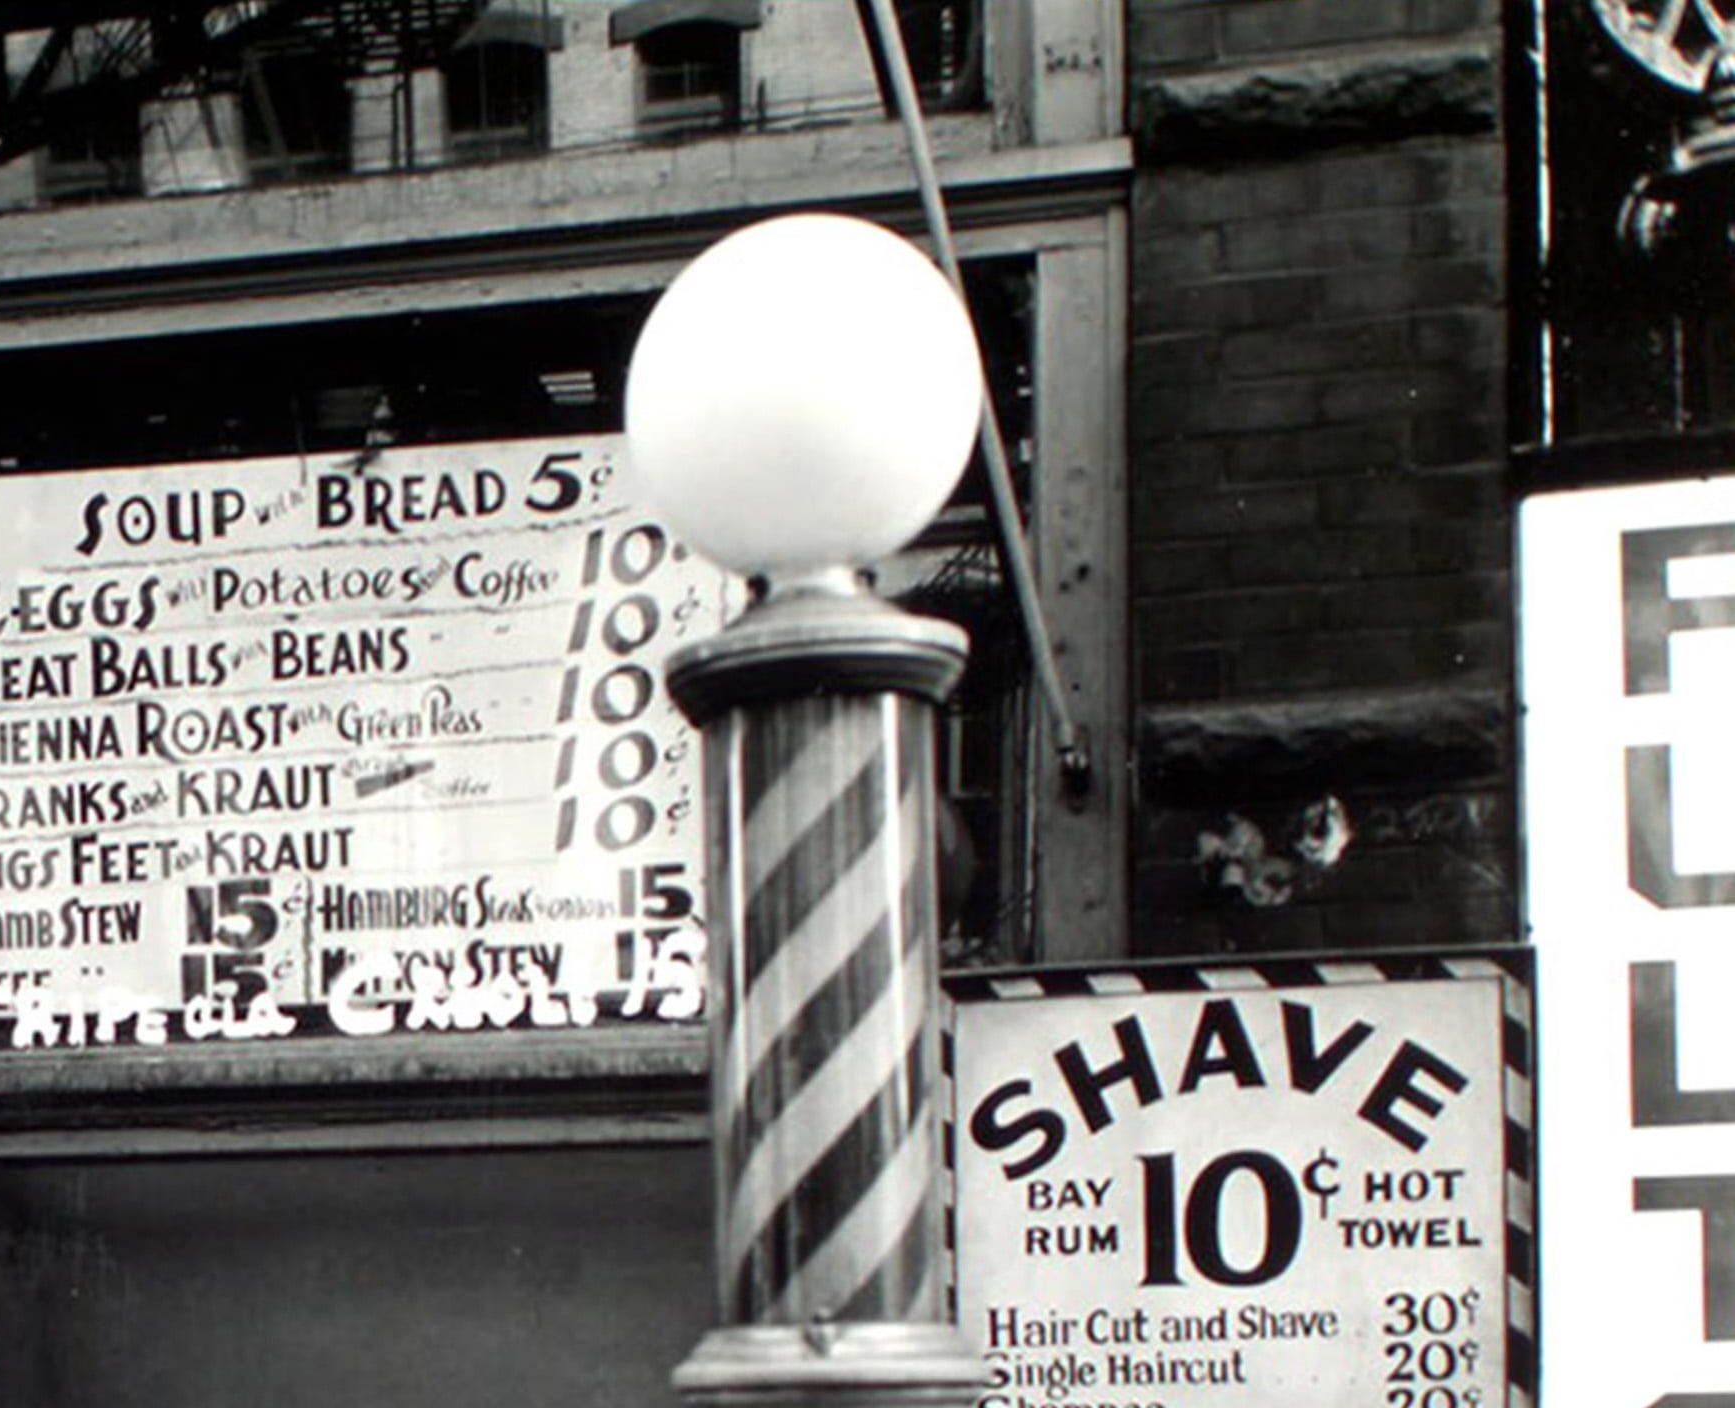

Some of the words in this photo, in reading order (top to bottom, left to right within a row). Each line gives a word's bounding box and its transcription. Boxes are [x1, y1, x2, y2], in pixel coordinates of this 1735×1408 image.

[76, 488, 245, 556] SOUP
[317, 468, 507, 533] BREAD
[213, 565, 421, 611] Potatoes
[91, 635, 227, 699] BALLS
[271, 625, 410, 680] BEANS
[137, 702, 287, 763] ROAST
[177, 763, 334, 818] KRAUT
[72, 833, 178, 885] FEET
[206, 828, 354, 875] KRAUT
[60, 899, 141, 948] STEW
[317, 883, 467, 932] HAMBURG
[618, 864, 692, 920] 15
[466, 939, 563, 988] STEW
[969, 998, 1471, 1183] SHAVE
[1027, 1178, 1115, 1211] BAY
[1365, 1169, 1465, 1202] HOT
[1025, 1224, 1119, 1256] RUM
[1135, 1148, 1341, 1288] 10¢
[1339, 1218, 1482, 1248] TOWEL
[988, 1308, 1078, 1348] Hair
[1086, 1312, 1149, 1344] Cut
[1160, 1308, 1228, 1343] and
[1237, 1305, 1339, 1341] Shave
[1383, 1286, 1480, 1336] 30¢
[984, 1353, 1096, 1399] Single
[1108, 1351, 1247, 1385] Haircut
[1386, 1341, 1479, 1382] 20¢
